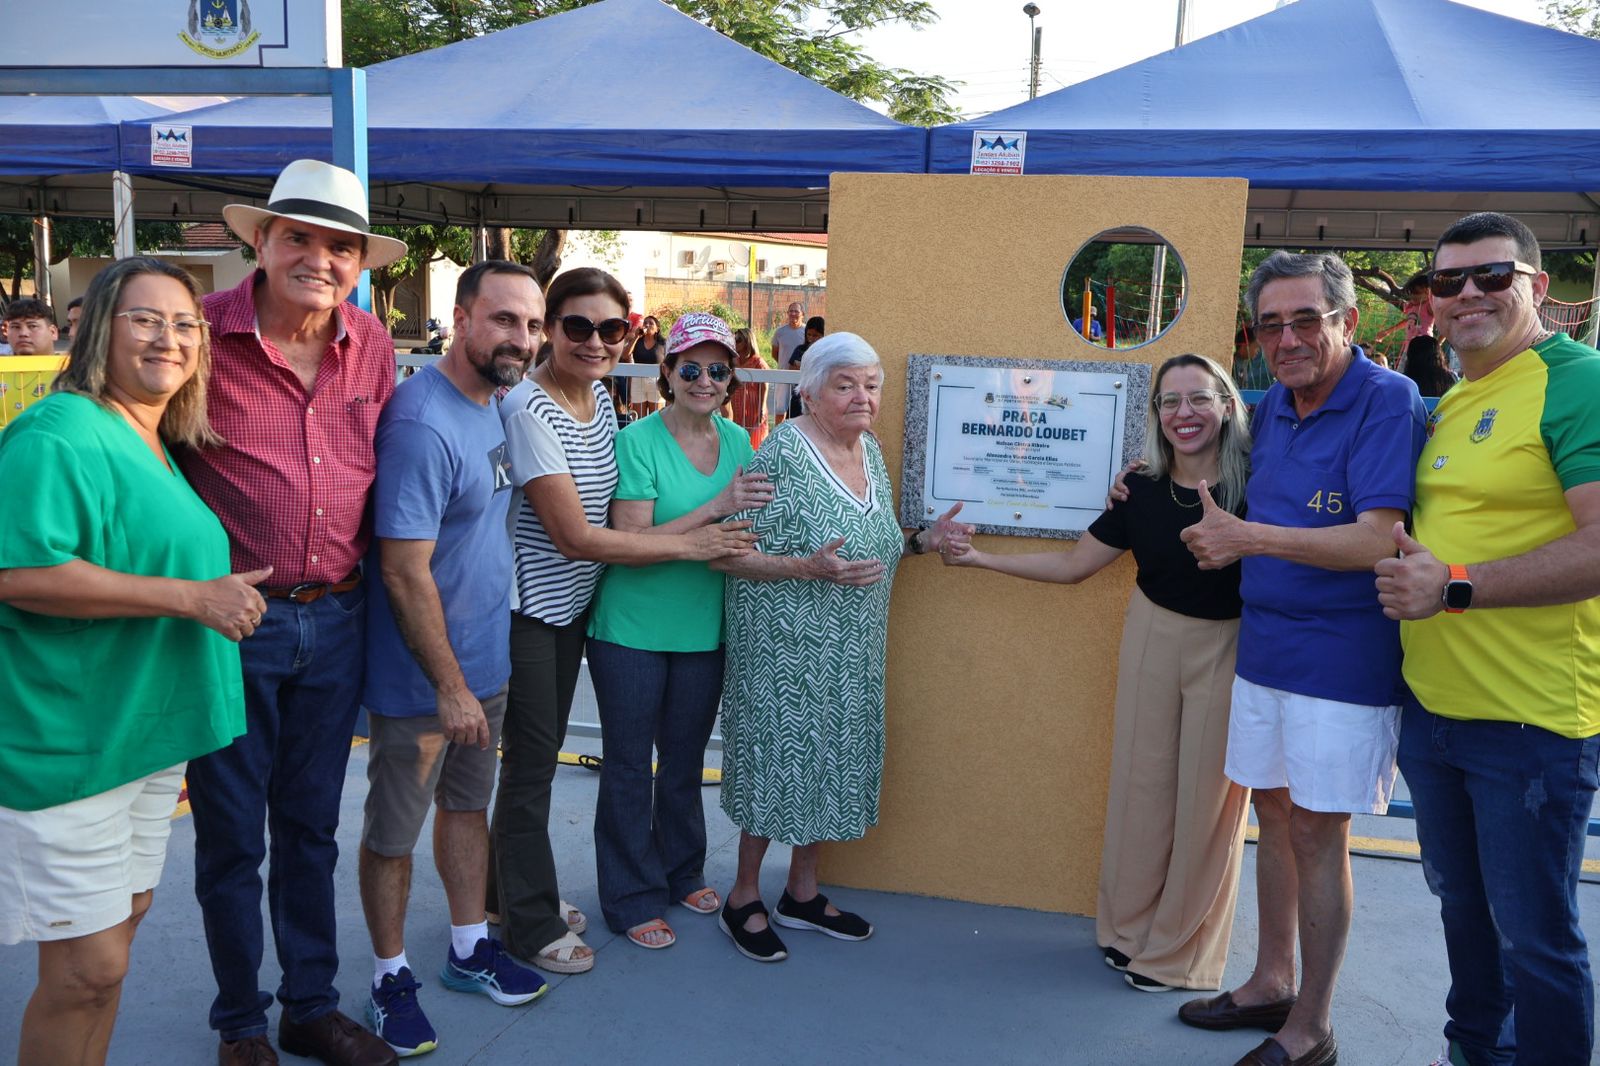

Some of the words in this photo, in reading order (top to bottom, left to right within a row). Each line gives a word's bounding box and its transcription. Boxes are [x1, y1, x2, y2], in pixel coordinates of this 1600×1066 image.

[1002, 410, 1047, 426] PRAÇA
[961, 422, 1033, 438] BERNARDO
[1035, 426, 1087, 442] LOUBET
[1306, 489, 1343, 514] 45
